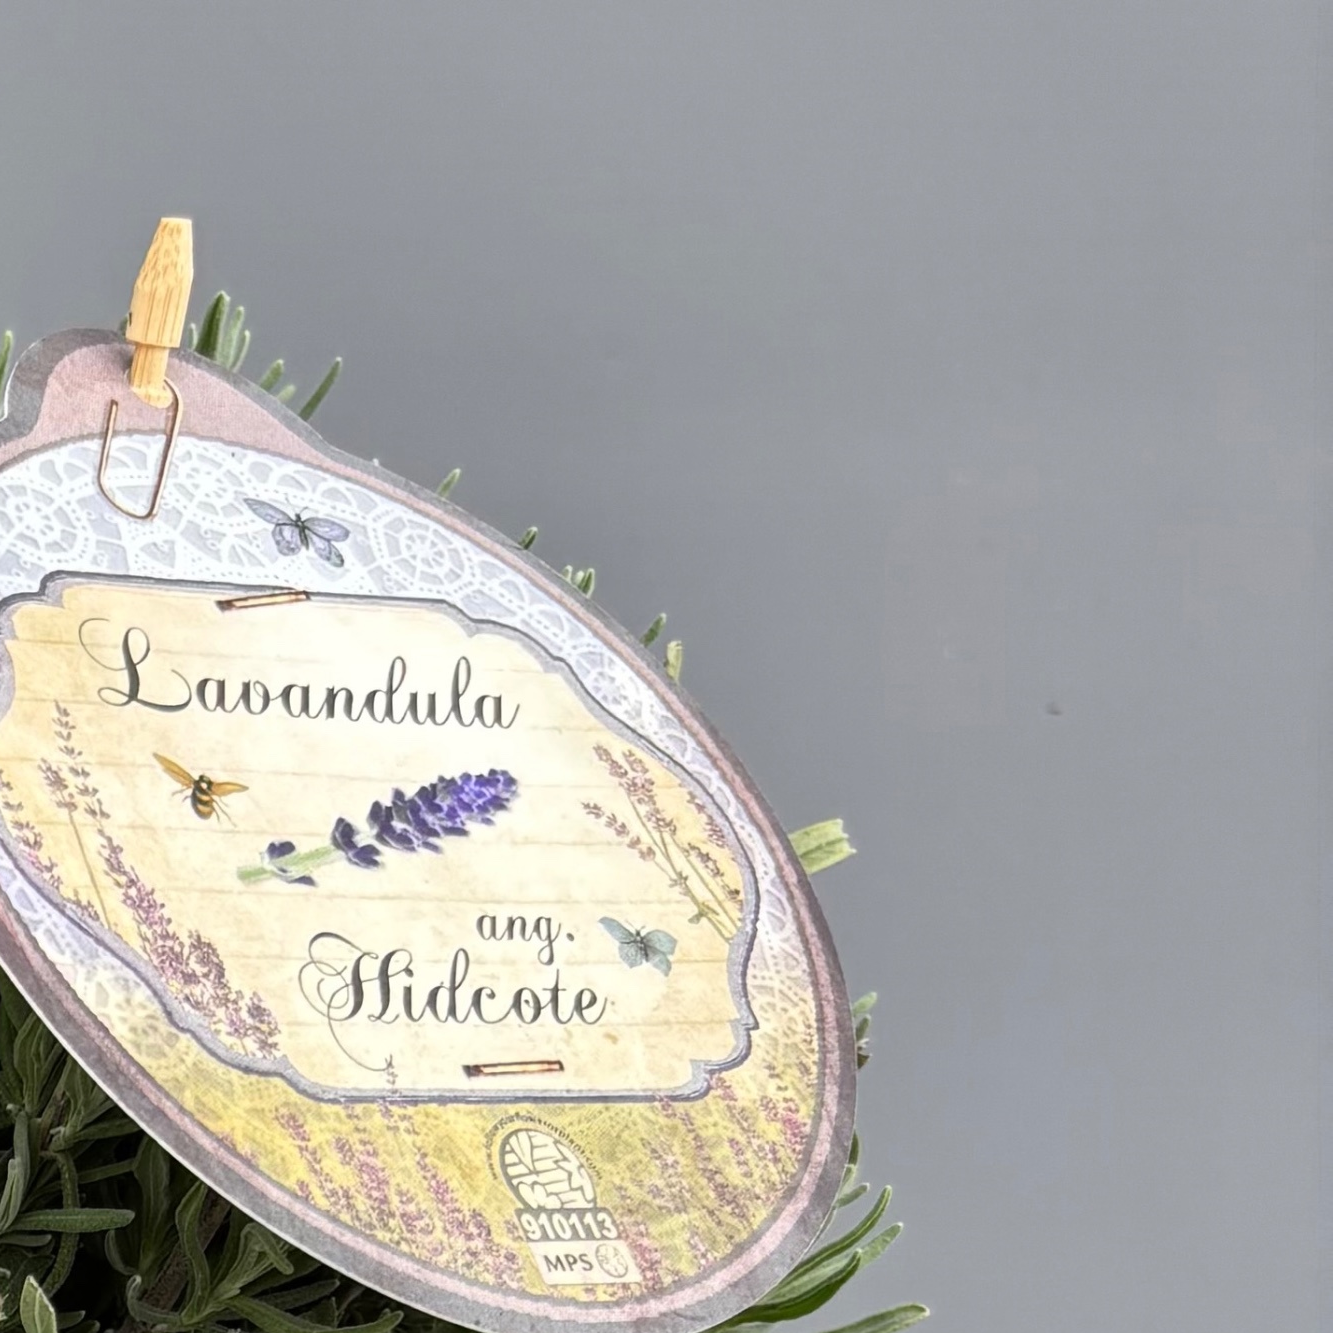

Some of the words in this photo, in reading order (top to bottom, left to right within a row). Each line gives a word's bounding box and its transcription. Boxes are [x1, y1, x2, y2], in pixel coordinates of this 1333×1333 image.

[78, 617, 521, 730] Lavandula
[475, 914, 575, 966] ang.
[298, 932, 608, 1071] Hidcote
[521, 1211, 619, 1240] 910113
[543, 1253, 594, 1273] MPS
